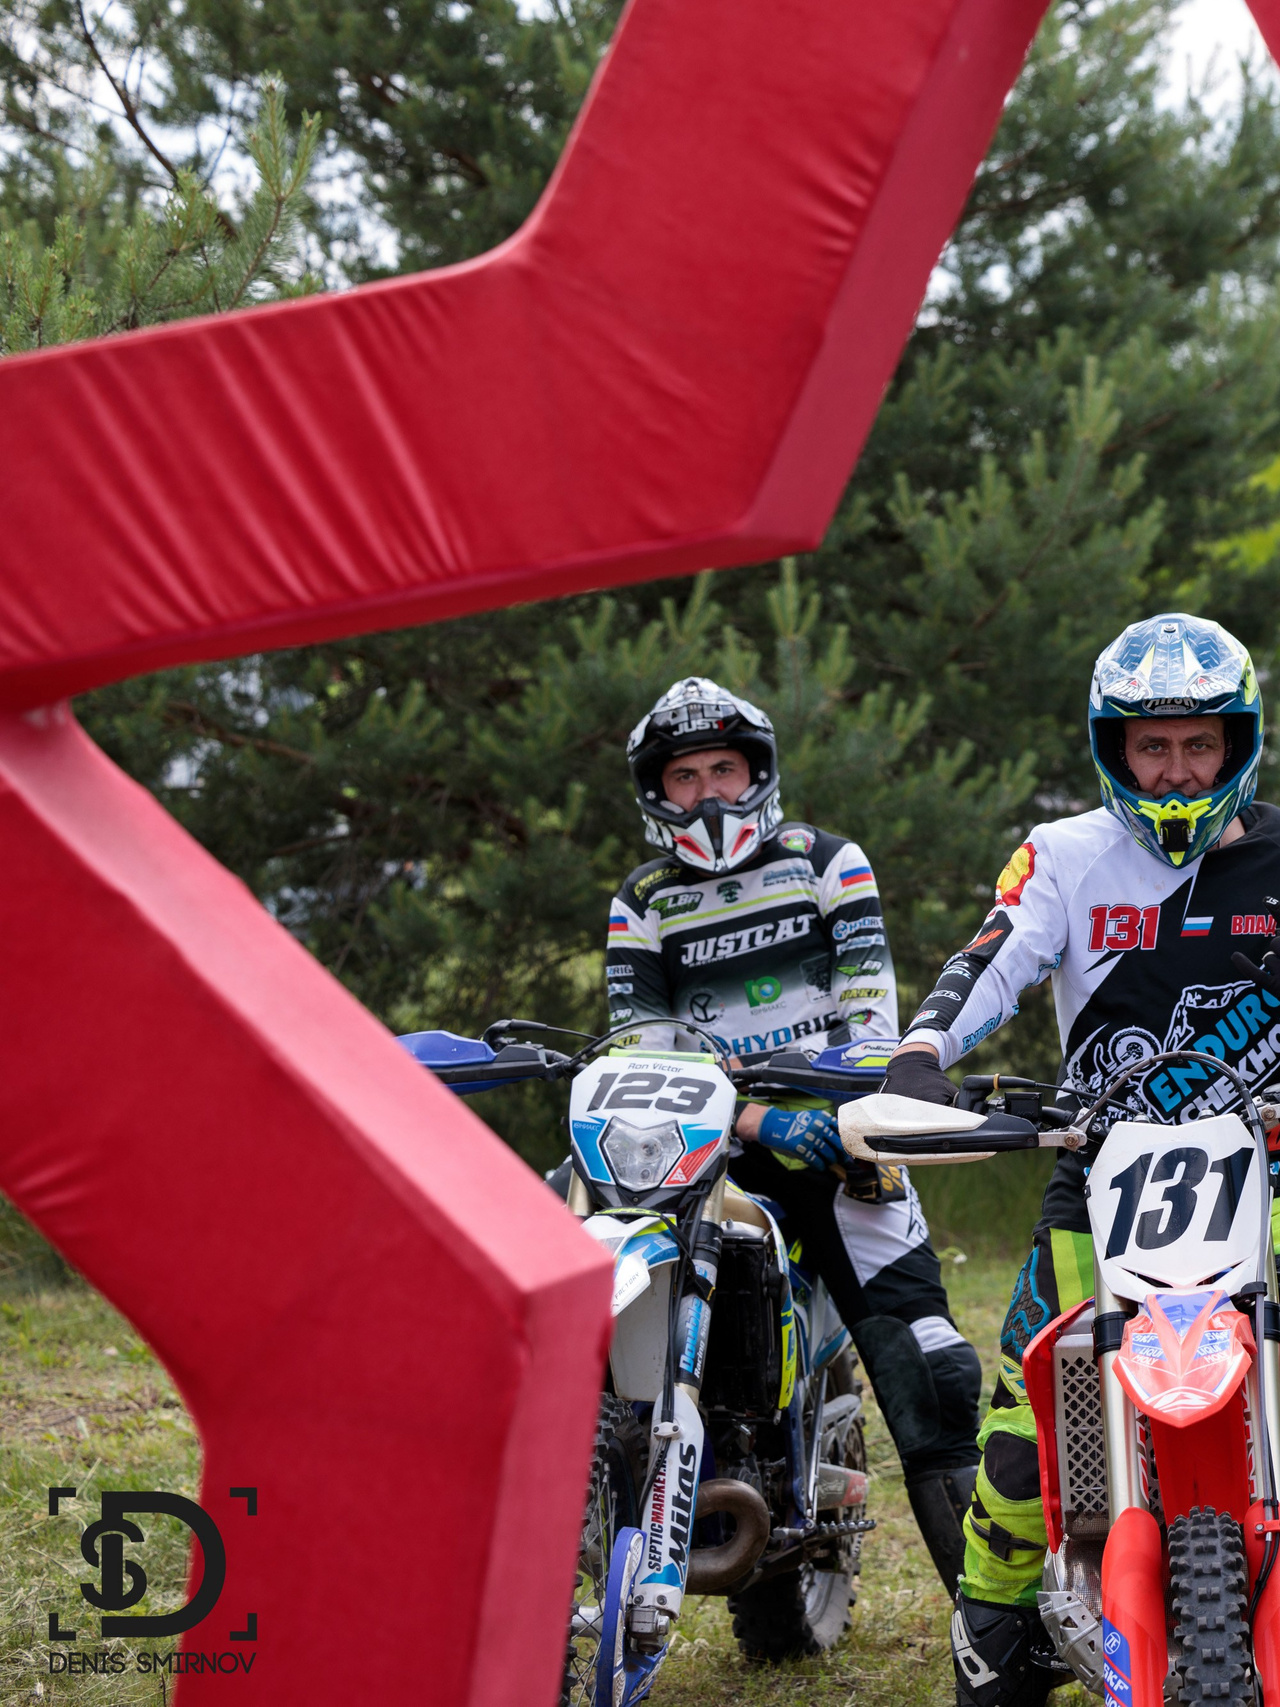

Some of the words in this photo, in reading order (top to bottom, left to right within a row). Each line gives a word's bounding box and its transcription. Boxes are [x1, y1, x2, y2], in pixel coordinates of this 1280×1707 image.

[672, 718, 724, 736] JUST1
[680, 913, 818, 966] JUSTCAT
[1088, 904, 1161, 952] 131
[1230, 914, 1278, 937] ВЛАД
[586, 1072, 717, 1115] 123
[1103, 1146, 1255, 1261] 131
[614, 1272, 640, 1300] FACTORY
[679, 1295, 704, 1374] Double
[1131, 1354, 1159, 1365] MOLY
[1203, 1352, 1229, 1364] MOLY
[669, 1443, 696, 1586] Mitas
[1103, 1661, 1130, 1692] SKF
